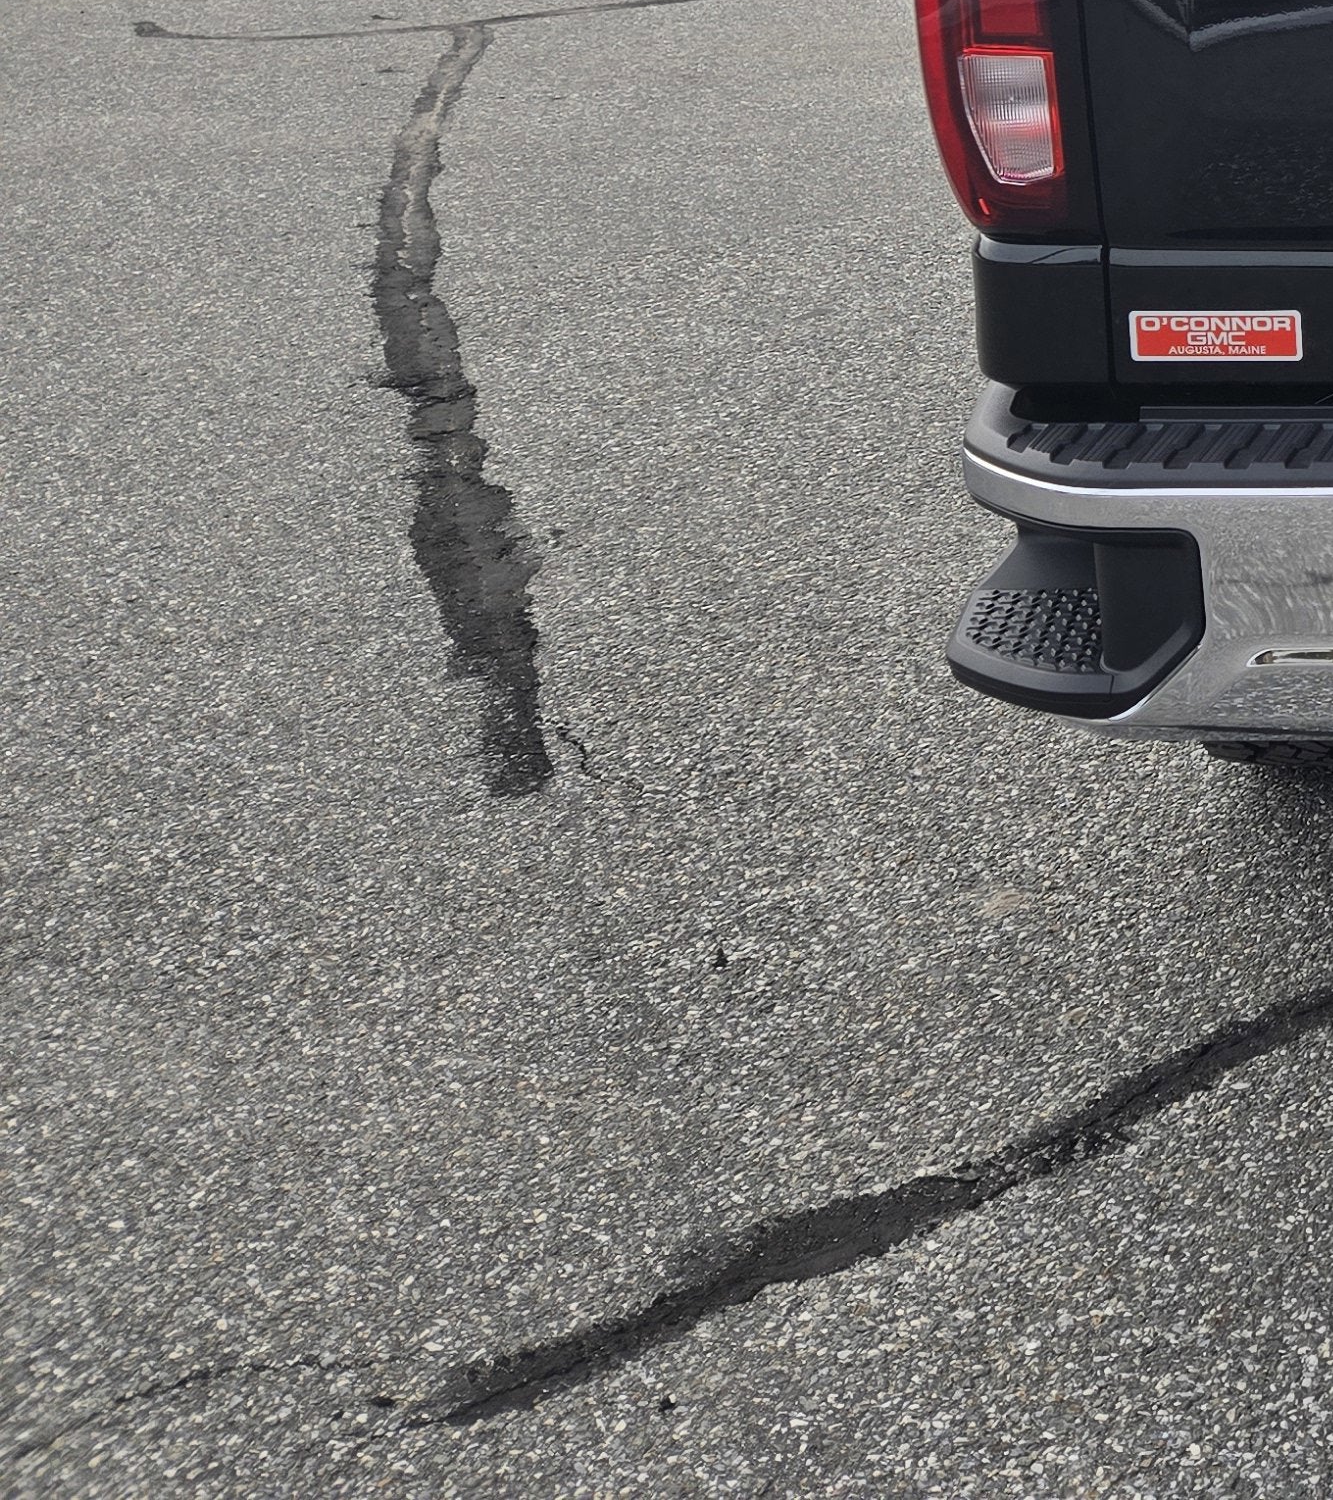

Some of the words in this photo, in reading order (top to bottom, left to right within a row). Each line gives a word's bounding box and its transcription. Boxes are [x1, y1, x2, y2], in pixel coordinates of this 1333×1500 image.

[1140, 316, 1291, 332] O'CONNOR
[1186, 332, 1246, 346] GMC
[1168, 345, 1226, 356] AUGUSTA,
[1228, 345, 1267, 355] MAINE
